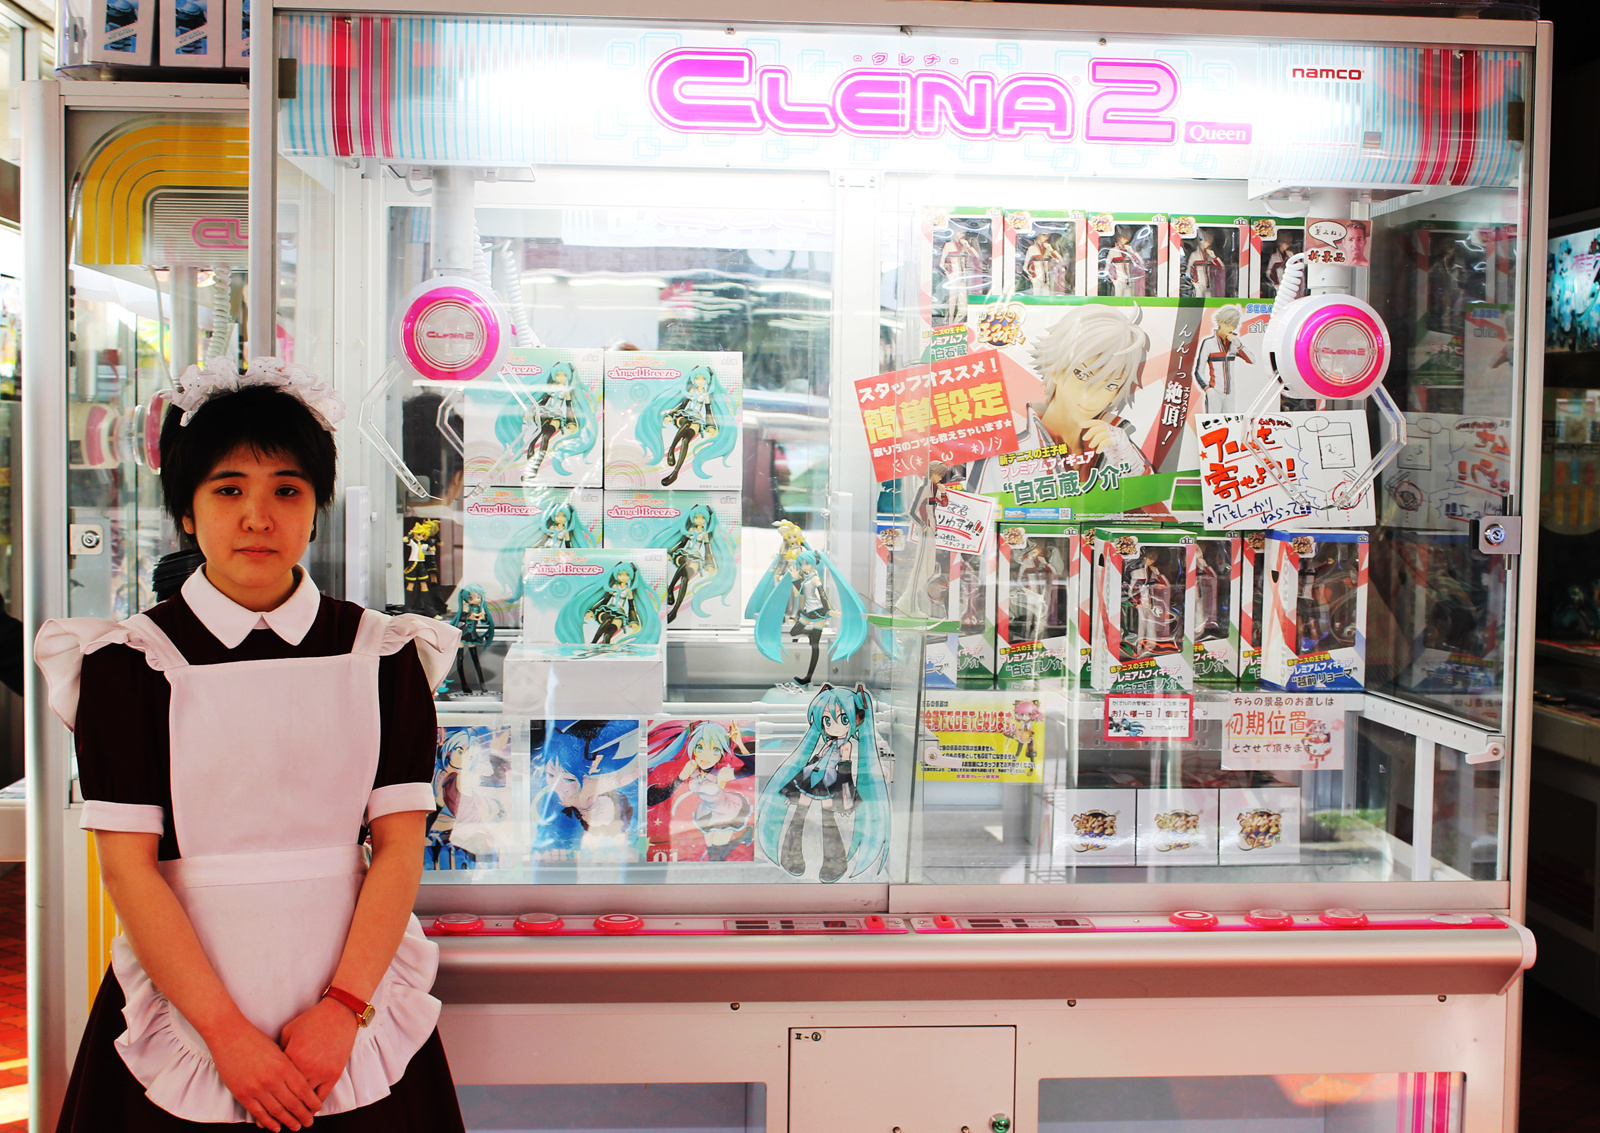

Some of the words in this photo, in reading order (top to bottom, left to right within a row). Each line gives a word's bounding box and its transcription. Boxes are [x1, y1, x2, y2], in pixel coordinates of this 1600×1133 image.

[1292, 67, 1362, 80] namco
[1189, 126, 1247, 143] Queen
[613, 368, 642, 379] Angel
[642, 368, 676, 378] Breeze
[863, 381, 1009, 445] 簡単設定
[999, 443, 1068, 466] 新テニスの王子様
[1000, 450, 1095, 479] プレミアムフィギュア
[472, 504, 501, 517] Angel
[613, 506, 641, 518] Angel
[642, 506, 672, 517] Breeze
[535, 564, 563, 576] Angel
[564, 563, 597, 574] Breeze
[1110, 664, 1182, 684] プレミアムフィギュア
[1232, 743, 1317, 754] とさせて頂きます。
